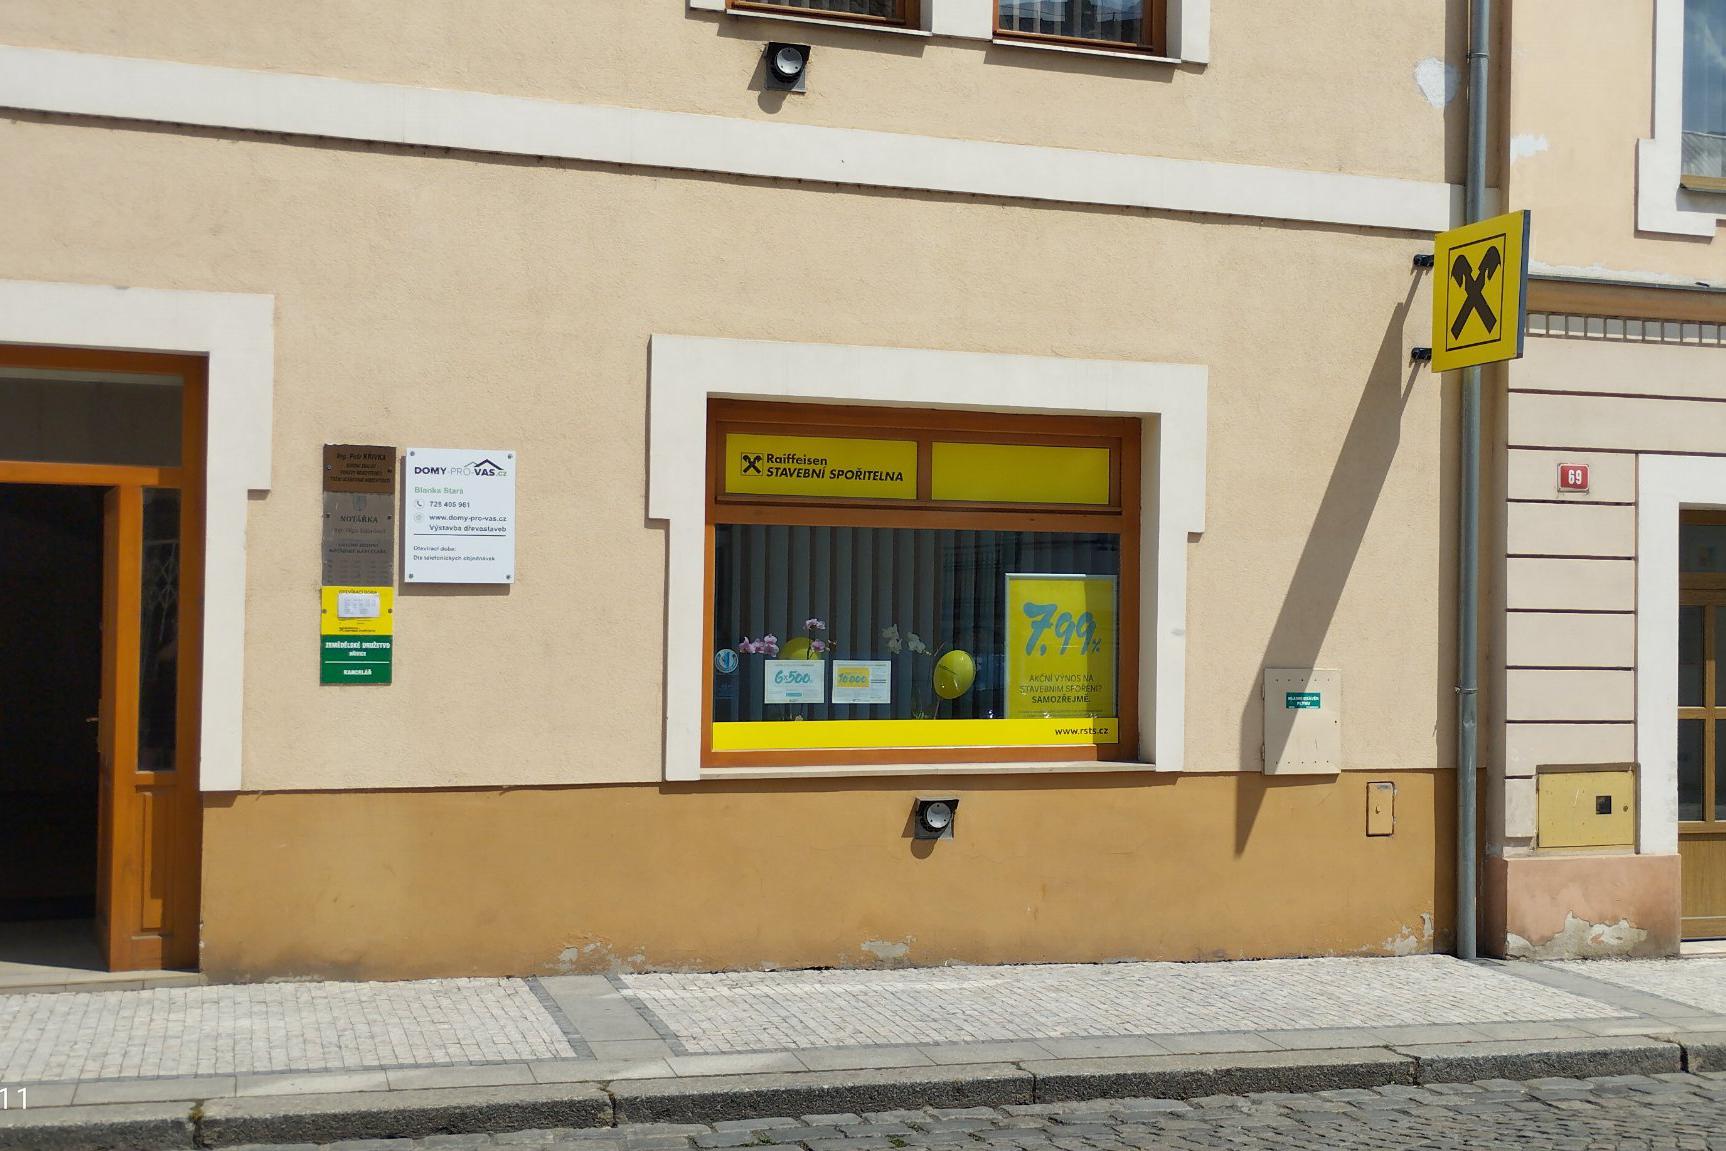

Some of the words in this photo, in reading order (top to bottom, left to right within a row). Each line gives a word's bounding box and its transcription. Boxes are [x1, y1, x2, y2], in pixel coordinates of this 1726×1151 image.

[767, 453, 828, 466] Raiffeisen
[767, 466, 826, 479] STAVEBNÍ
[829, 468, 904, 482] SPOŘITELNA
[1568, 469, 1582, 485] 69
[429, 514, 507, 523] www.domy-pro-vas.cz
[429, 523, 462, 532] Výstavba
[1083, 674, 1094, 683] NA
[1055, 726, 1109, 736] www.rsts.cz
